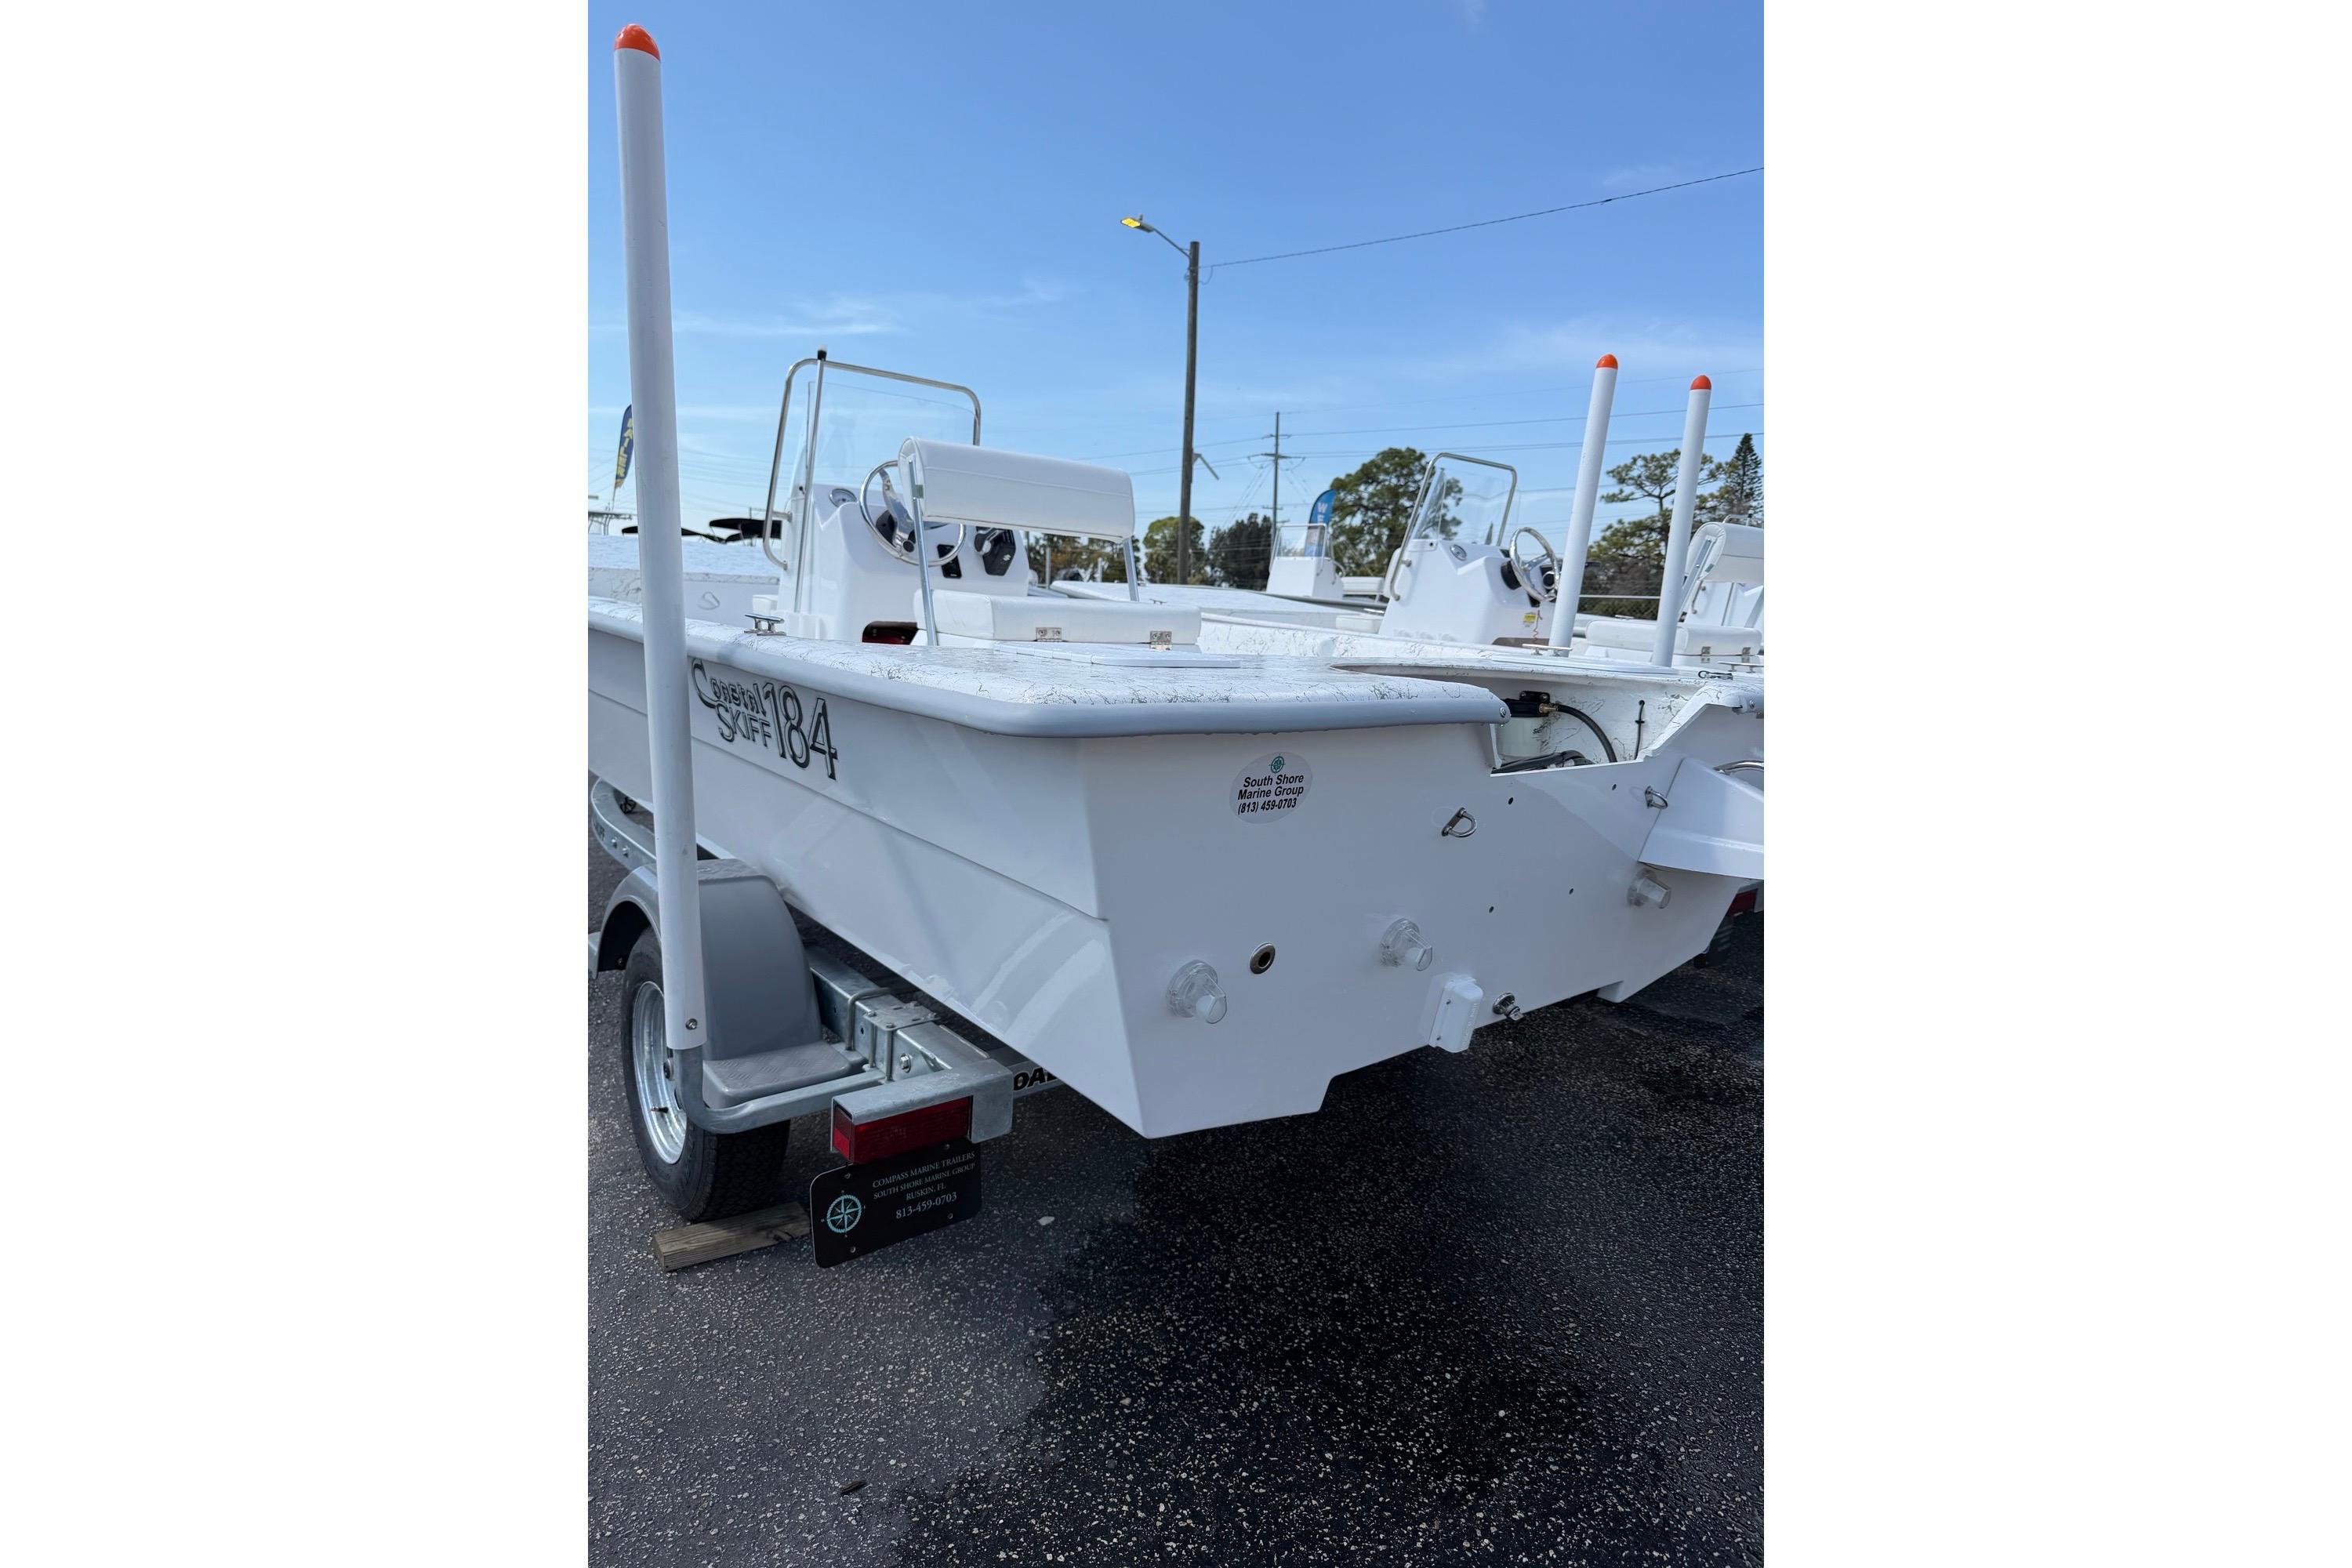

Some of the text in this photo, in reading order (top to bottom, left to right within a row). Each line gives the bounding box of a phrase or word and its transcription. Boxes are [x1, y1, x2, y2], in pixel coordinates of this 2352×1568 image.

[716, 703, 771, 748] SKIFF
[763, 682, 838, 780] 184
[1238, 786, 1305, 800] Marine Group
[1243, 774, 1304, 788] South Shore
[1238, 797, 1298, 815] (813) 459-0703
[873, 1152, 975, 1188] COMPASS MARINE TRAILERS
[873, 1163, 975, 1200] SOUTH SHORE MARINE GROUP
[906, 1182, 946, 1201] RUSKIN, FL
[896, 1192, 956, 1219] 813-459-0703
